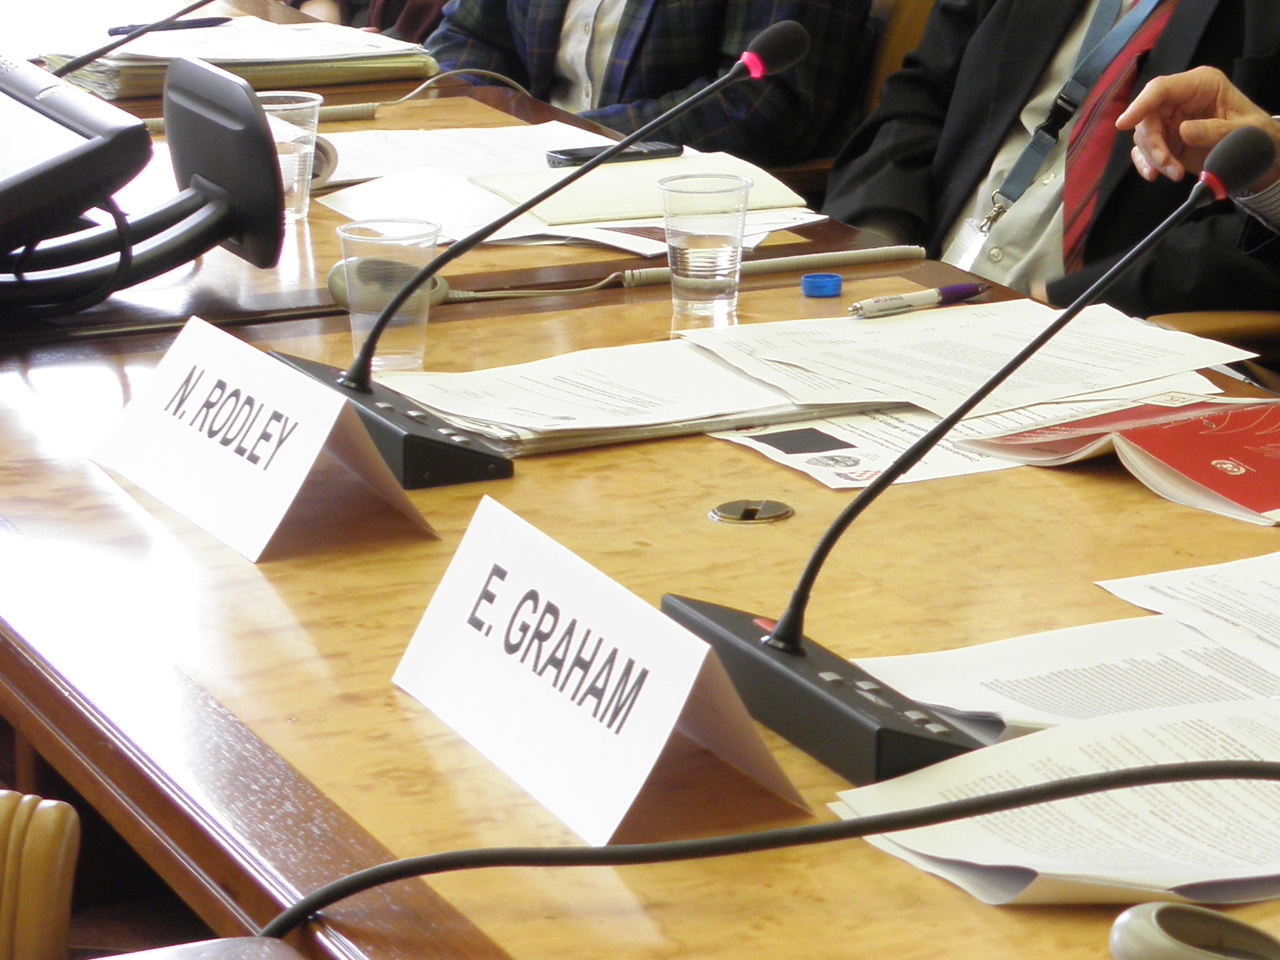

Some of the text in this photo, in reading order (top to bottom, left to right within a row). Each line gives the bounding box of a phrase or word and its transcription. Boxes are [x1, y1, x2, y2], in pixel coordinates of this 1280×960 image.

[164, 365, 299, 471] N. RODLEY
[466, 563, 649, 735] E. GRAHAM
